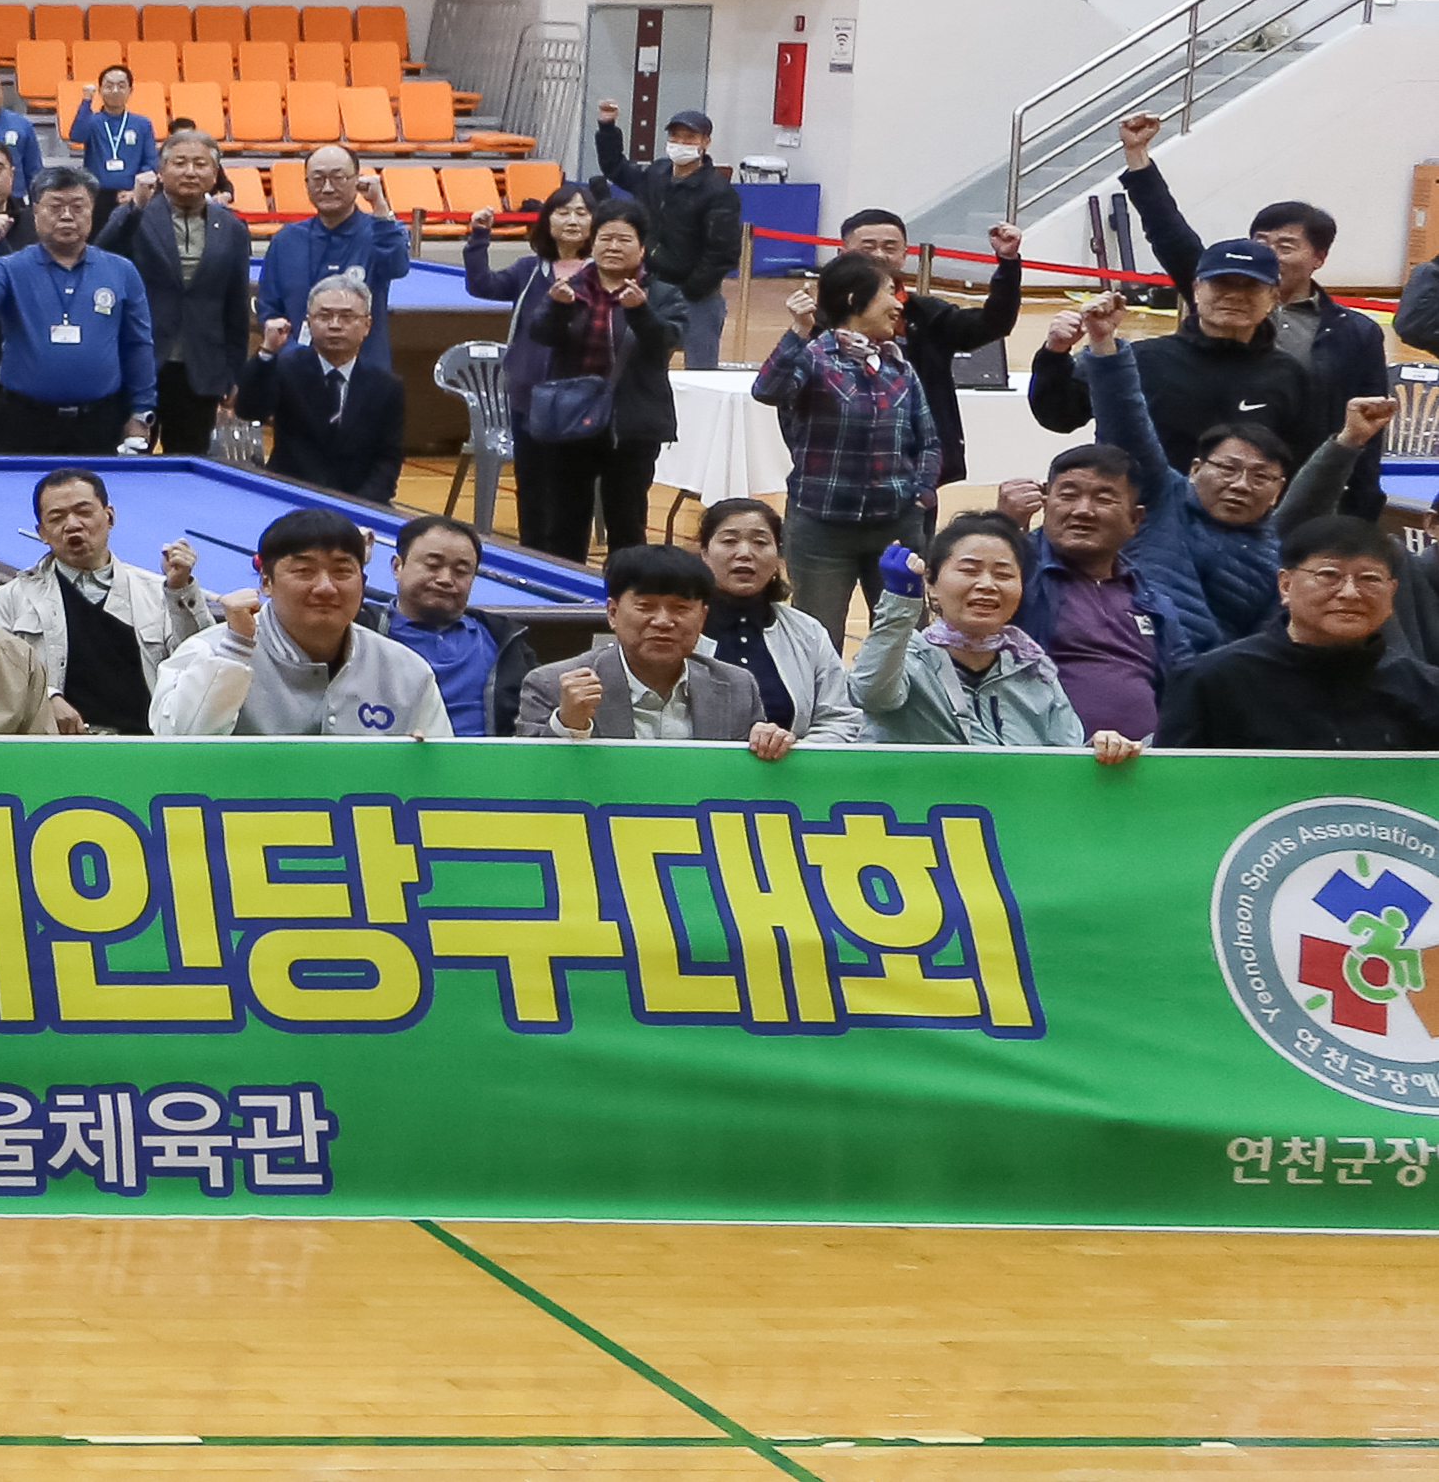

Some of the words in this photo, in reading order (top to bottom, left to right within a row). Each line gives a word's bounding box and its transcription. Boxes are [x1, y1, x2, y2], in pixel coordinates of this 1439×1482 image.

[1240, 834, 1298, 891] Sports
[1297, 820, 1437, 860] Association
[1233, 892, 1282, 1023] Yeoncheon
[1292, 1027, 1439, 1097] 연천군장애
[1225, 1135, 1439, 1187] 연천군장
